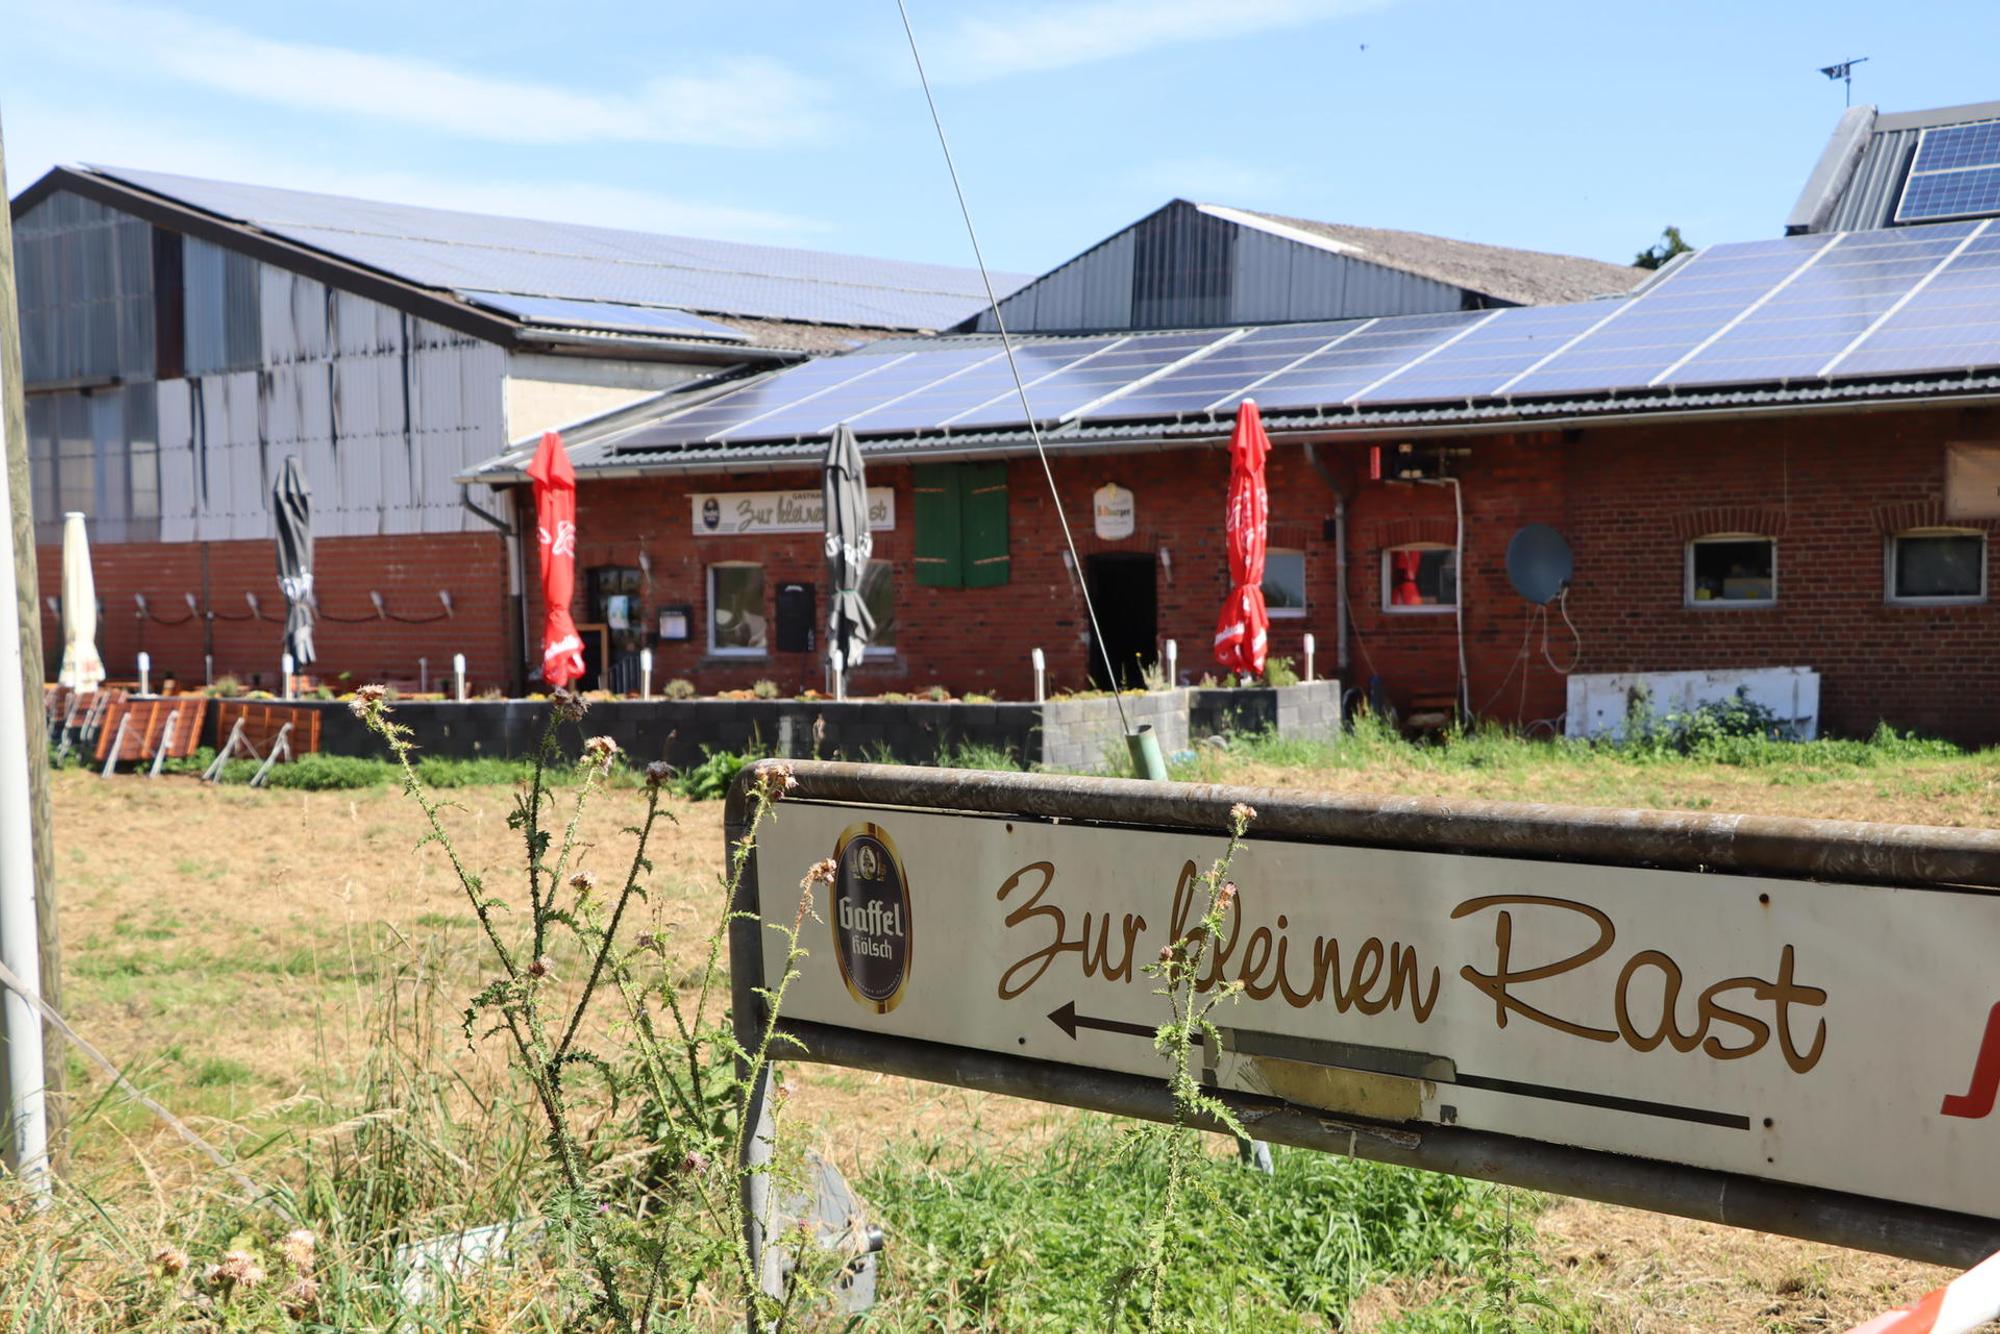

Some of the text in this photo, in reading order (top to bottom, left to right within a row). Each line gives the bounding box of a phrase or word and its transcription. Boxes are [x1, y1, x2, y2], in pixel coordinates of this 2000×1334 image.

[736, 499, 773, 532] Zur
[777, 495, 823, 524] kleine
[839, 896, 904, 937] Gaffel
[852, 935, 892, 960] Kölsch
[996, 860, 1147, 1000] Zur
[1169, 859, 1441, 1024] kleinen
[1450, 894, 1828, 1074] Rast
